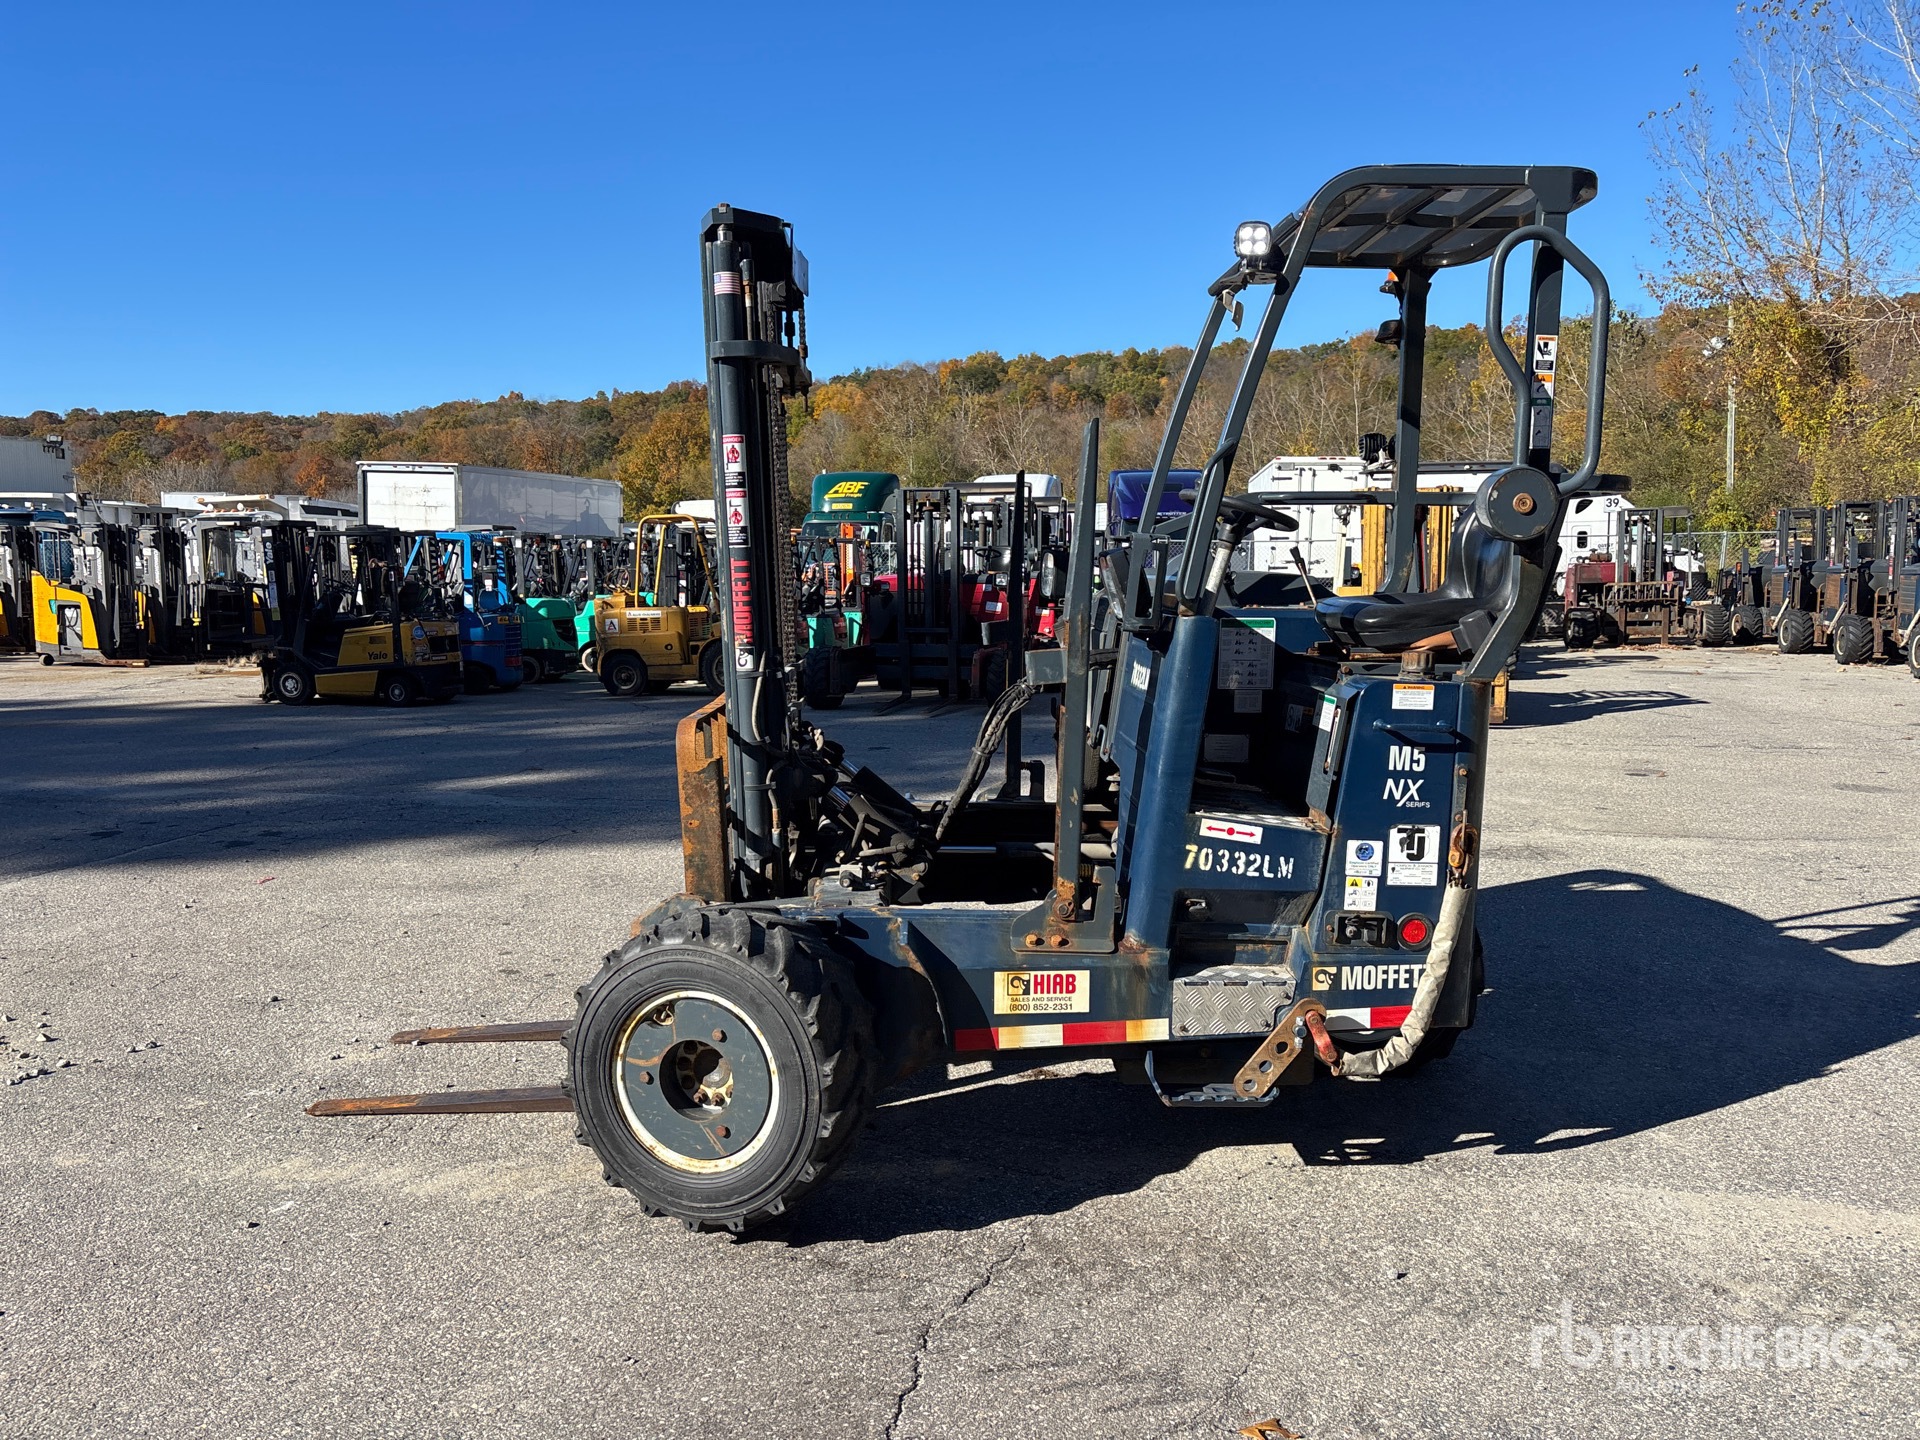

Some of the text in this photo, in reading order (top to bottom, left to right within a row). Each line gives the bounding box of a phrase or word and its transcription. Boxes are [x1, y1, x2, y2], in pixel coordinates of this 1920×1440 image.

[827, 481, 870, 494] ABF
[1605, 497, 1620, 508] 39
[265, 541, 275, 565] Yale
[730, 557, 753, 646] MOFFETT
[367, 651, 389, 661] Yale
[1388, 745, 1427, 772] M5
[1382, 778, 1425, 808] NX
[1184, 844, 1295, 880] 70332LM
[1033, 973, 1077, 995] HIAB
[1341, 964, 1427, 991] MOFFET
[1009, 1003, 1073, 1012] (800) 852-2331
